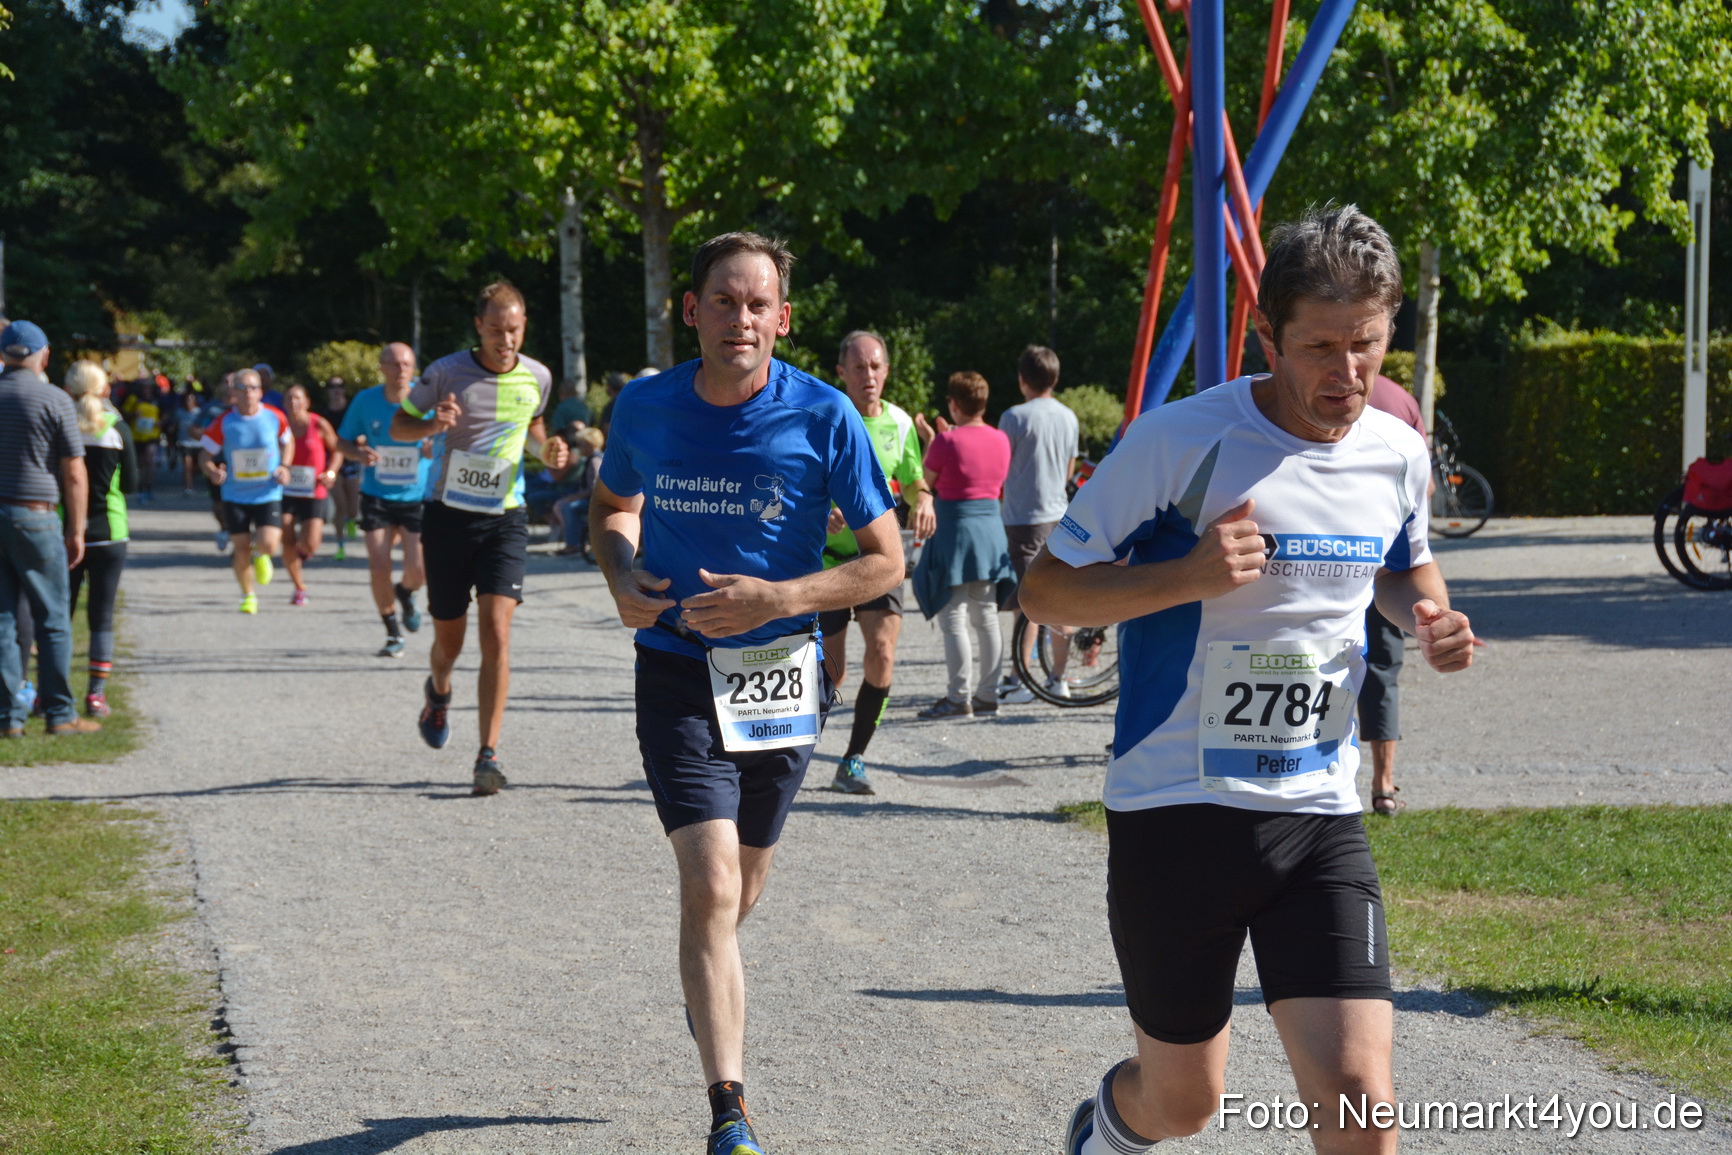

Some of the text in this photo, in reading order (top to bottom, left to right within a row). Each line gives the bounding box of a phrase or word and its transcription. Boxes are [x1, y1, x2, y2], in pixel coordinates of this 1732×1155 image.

[457, 467, 501, 489] 3084
[655, 474, 742, 494] Kirwaläufer
[653, 496, 745, 516] Pettenhofen
[1286, 539, 1379, 558] BÜSCHEL
[742, 647, 791, 662] BOCK
[1250, 653, 1317, 669] BOCK
[726, 667, 803, 705] 2328
[738, 705, 792, 717] PARTL Neumarkt
[1224, 681, 1333, 727] 2784
[1207, 716, 1215, 725] C
[748, 723, 792, 738] Johann
[1234, 733, 1312, 744] PARTL Neumarkt
[1256, 754, 1302, 773] Peter
